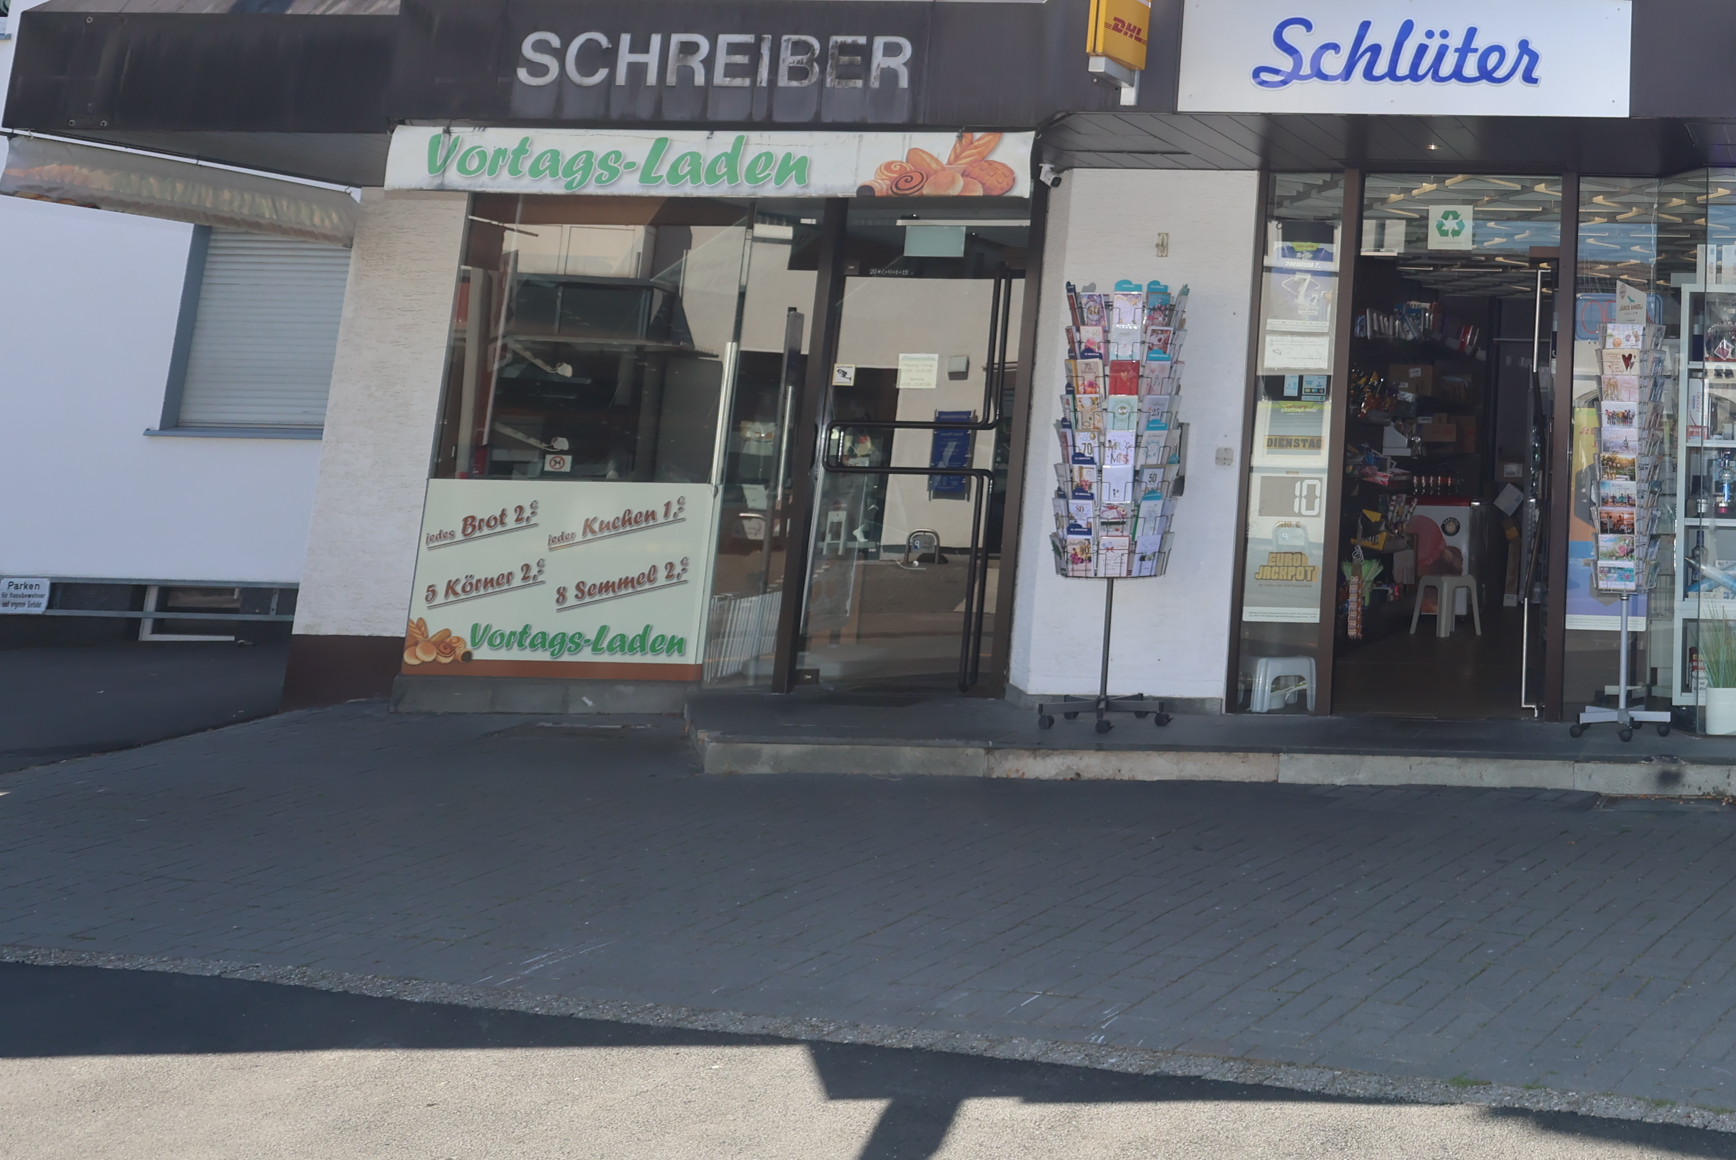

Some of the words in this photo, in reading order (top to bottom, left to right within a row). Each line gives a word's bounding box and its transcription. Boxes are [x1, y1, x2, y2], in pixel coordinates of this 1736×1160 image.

[1110, 16, 1144, 43] DHL
[516, 31, 912, 89] SCHREIBER
[1250, 16, 1541, 88] Schlüter
[427, 132, 809, 191] Vortags-Laden
[1293, 479, 1321, 516] 10
[425, 528, 455, 546] jedes
[461, 508, 508, 537] Brot
[582, 508, 657, 538] Kuchen
[7, 581, 41, 590] Parken
[425, 584, 437, 603] 5
[444, 569, 515, 598] Körner
[555, 586, 568, 605] 8
[574, 565, 658, 600] Semmel
[470, 622, 687, 657] Vortags-Laden
